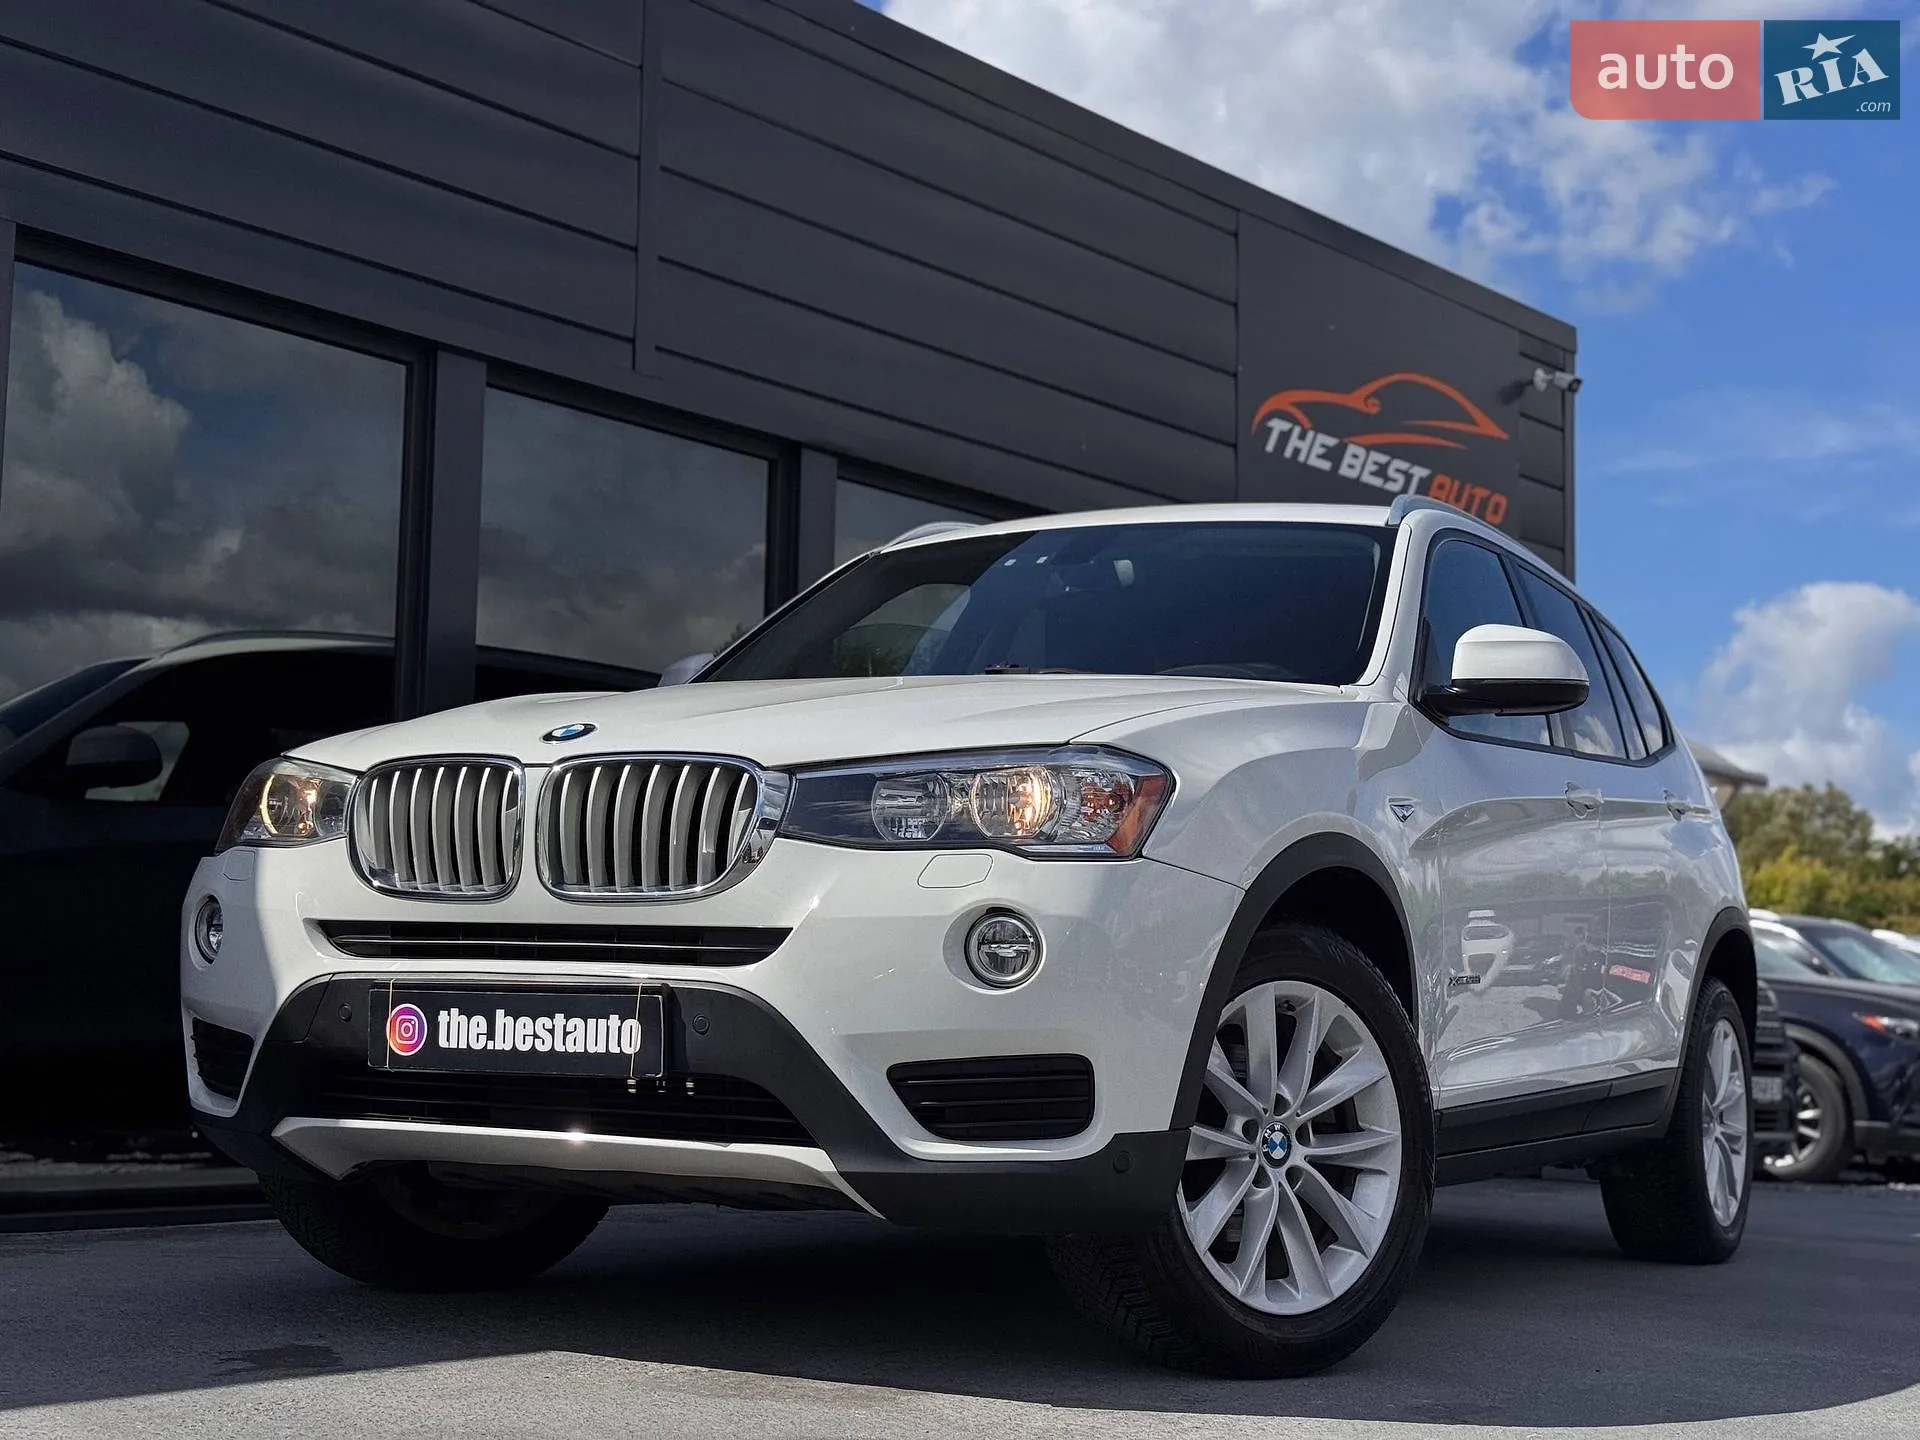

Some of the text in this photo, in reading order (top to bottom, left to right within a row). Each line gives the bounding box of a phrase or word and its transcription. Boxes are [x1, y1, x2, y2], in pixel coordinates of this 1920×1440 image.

[1264, 417, 1508, 525] THE BEST AUTO
[438, 1007, 642, 1055] the.bestauto
